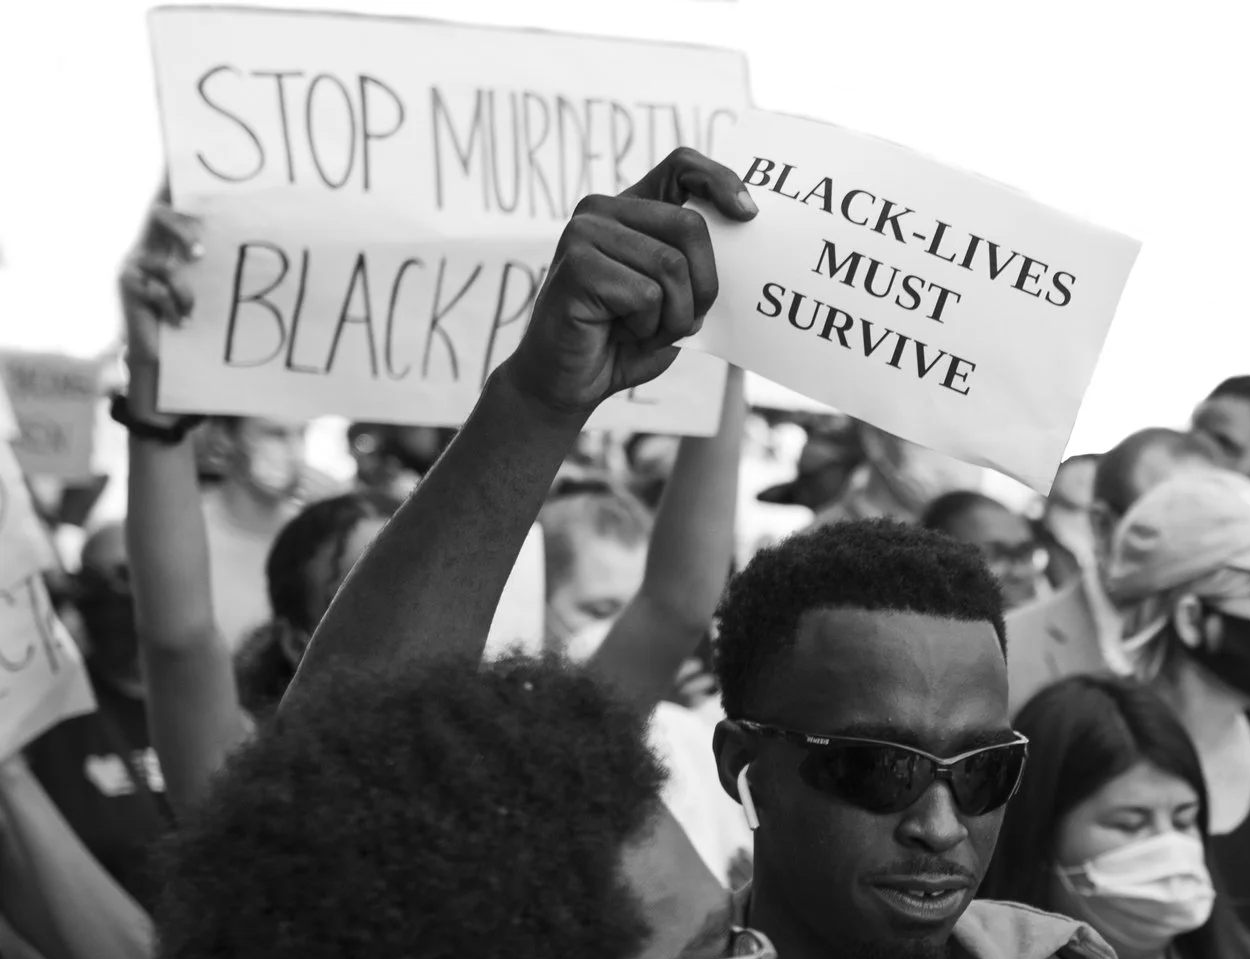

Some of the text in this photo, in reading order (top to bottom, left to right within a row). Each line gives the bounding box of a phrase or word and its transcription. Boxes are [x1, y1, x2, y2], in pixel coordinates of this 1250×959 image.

[195, 64, 405, 192] STOP
[742, 156, 1077, 307] BLACK-LIVES
[811, 238, 962, 324] MUST
[223, 241, 484, 380] BLACK
[755, 282, 977, 396] SURVIVE
